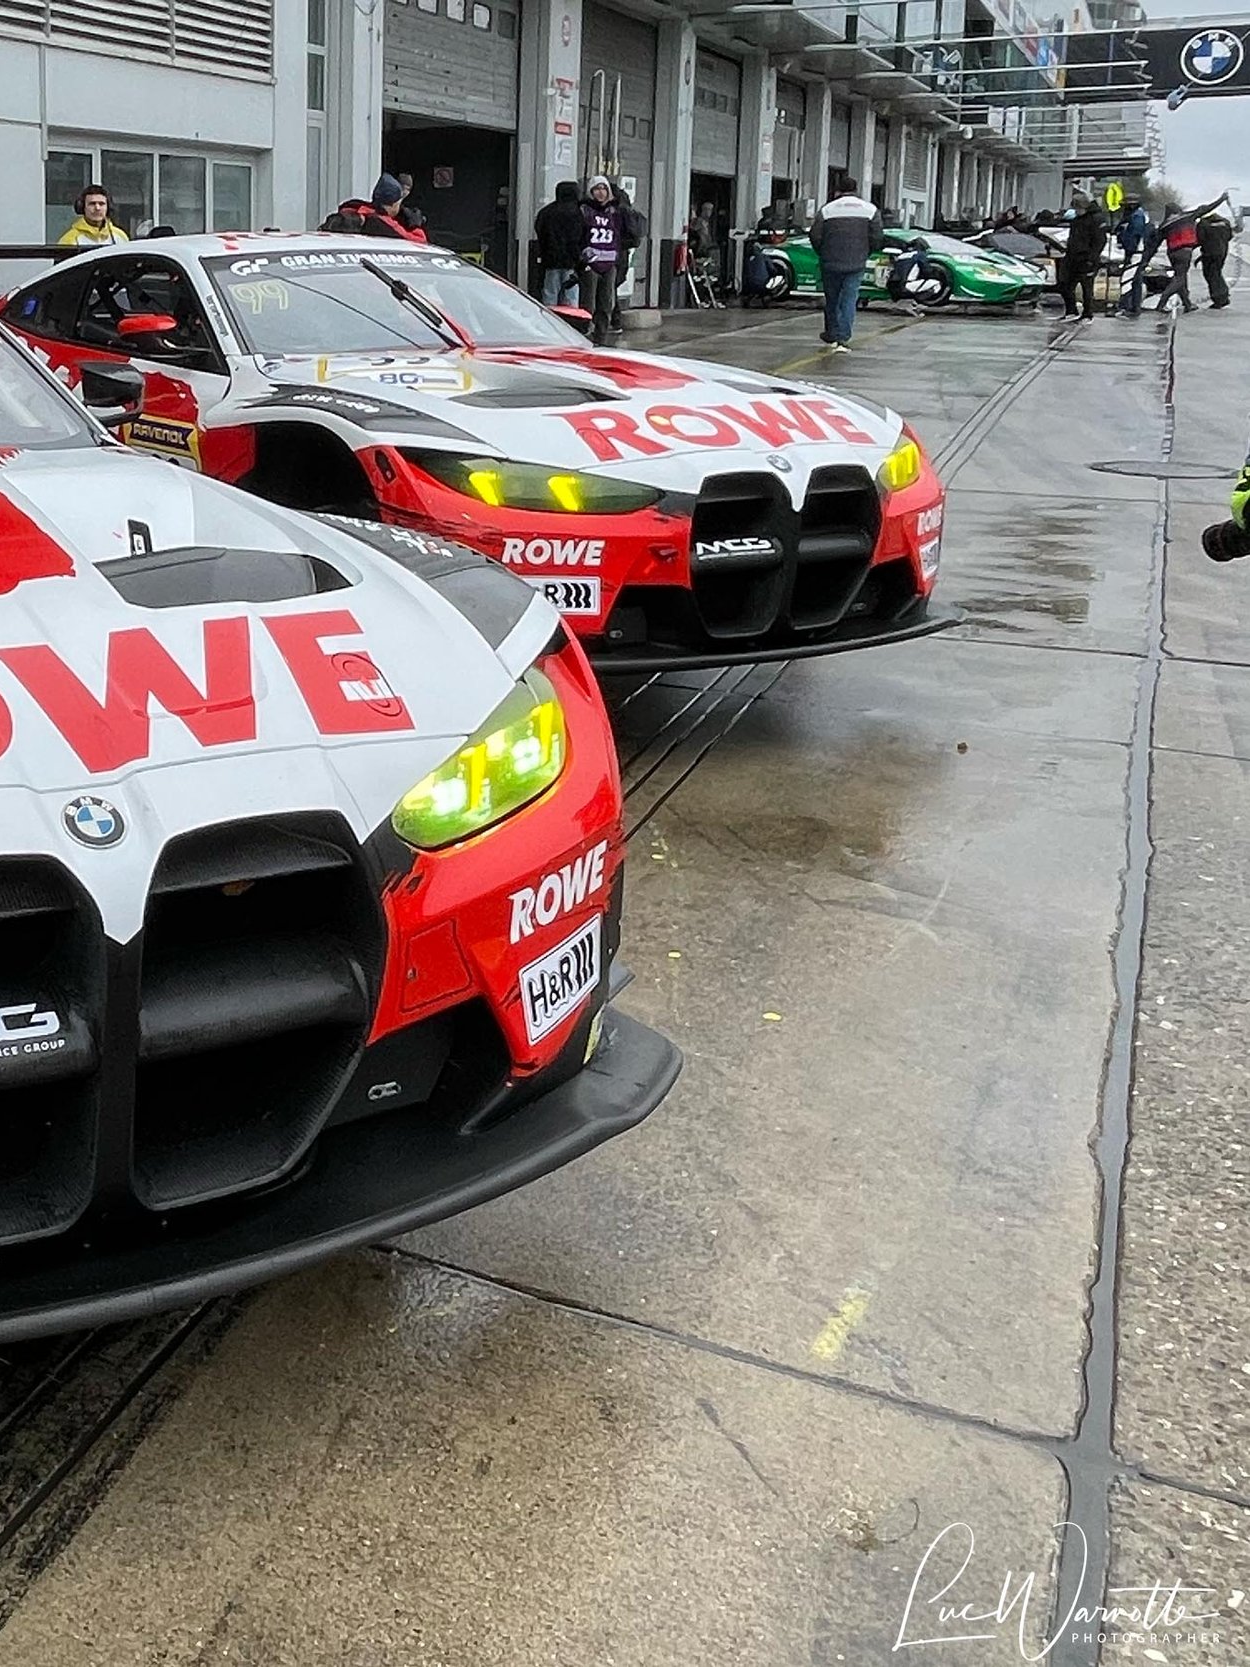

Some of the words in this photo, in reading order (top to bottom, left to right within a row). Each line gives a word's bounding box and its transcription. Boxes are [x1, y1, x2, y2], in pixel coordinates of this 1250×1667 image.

[281, 254, 335, 267] GRAN
[228, 280, 289, 315] 99
[134, 423, 186, 445] RAVENOL
[557, 399, 877, 462] ROWE
[502, 538, 606, 567] ROWE
[508, 839, 608, 945] ROWE
[528, 955, 572, 1022] H&R
[24, 1039, 66, 1053] GROUP
